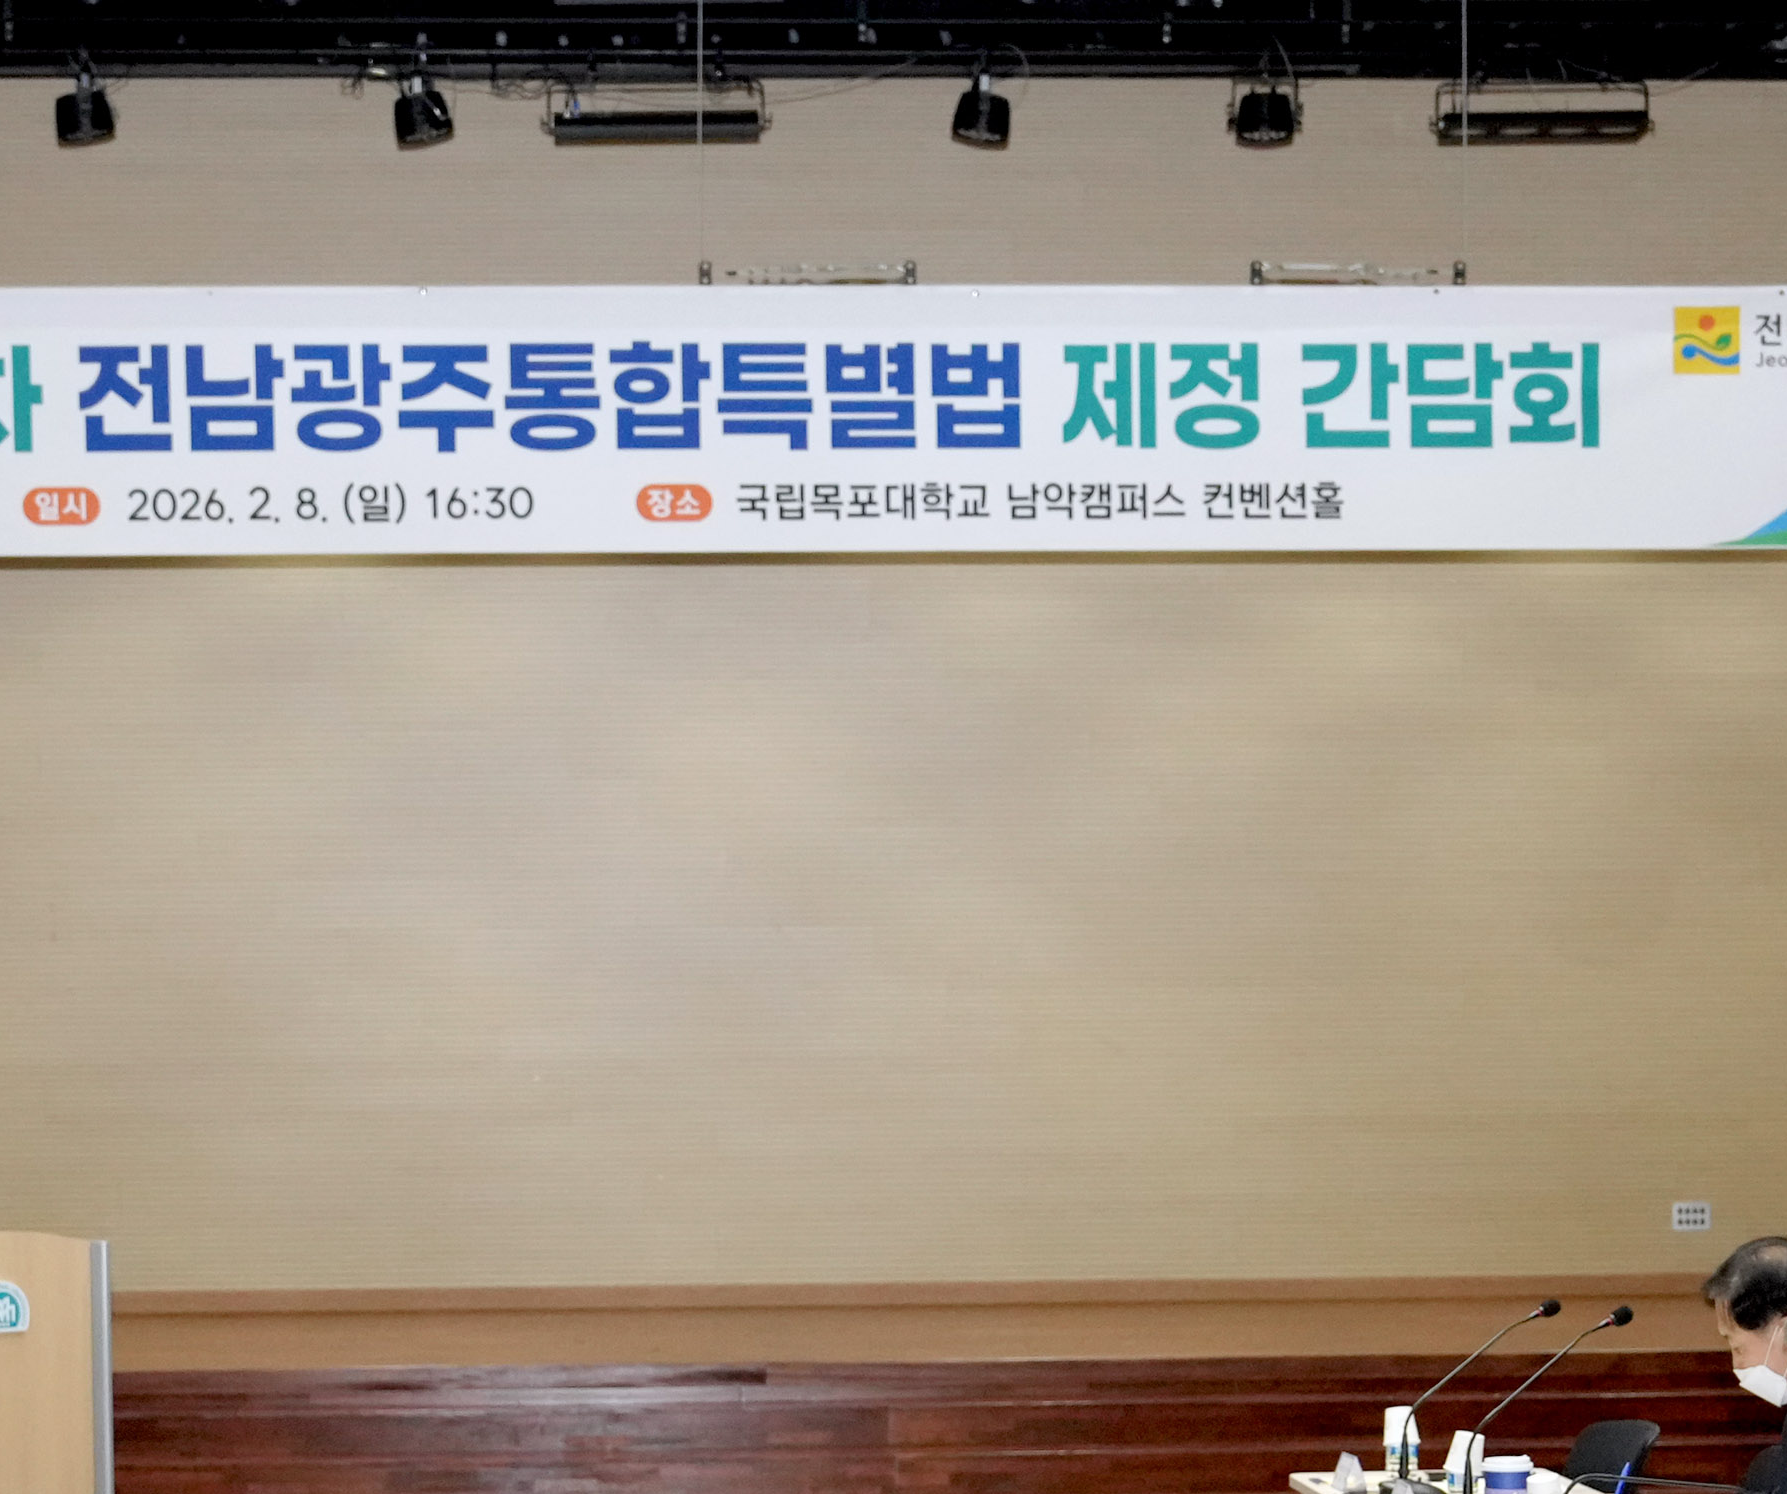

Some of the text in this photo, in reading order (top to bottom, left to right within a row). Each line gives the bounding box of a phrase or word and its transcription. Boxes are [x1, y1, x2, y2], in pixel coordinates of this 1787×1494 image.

[77, 341, 1022, 454] 전남광주통합특별법
[1061, 341, 1261, 451] 제정
[1300, 340, 1601, 450] 간담회
[34, 493, 89, 521] 일시
[343, 482, 407, 525] (일)
[425, 486, 535, 521] 16:30
[648, 489, 701, 518] 장소
[735, 480, 1344, 521] 국립목포대학교 남악캠퍼스 컨벤션홀
